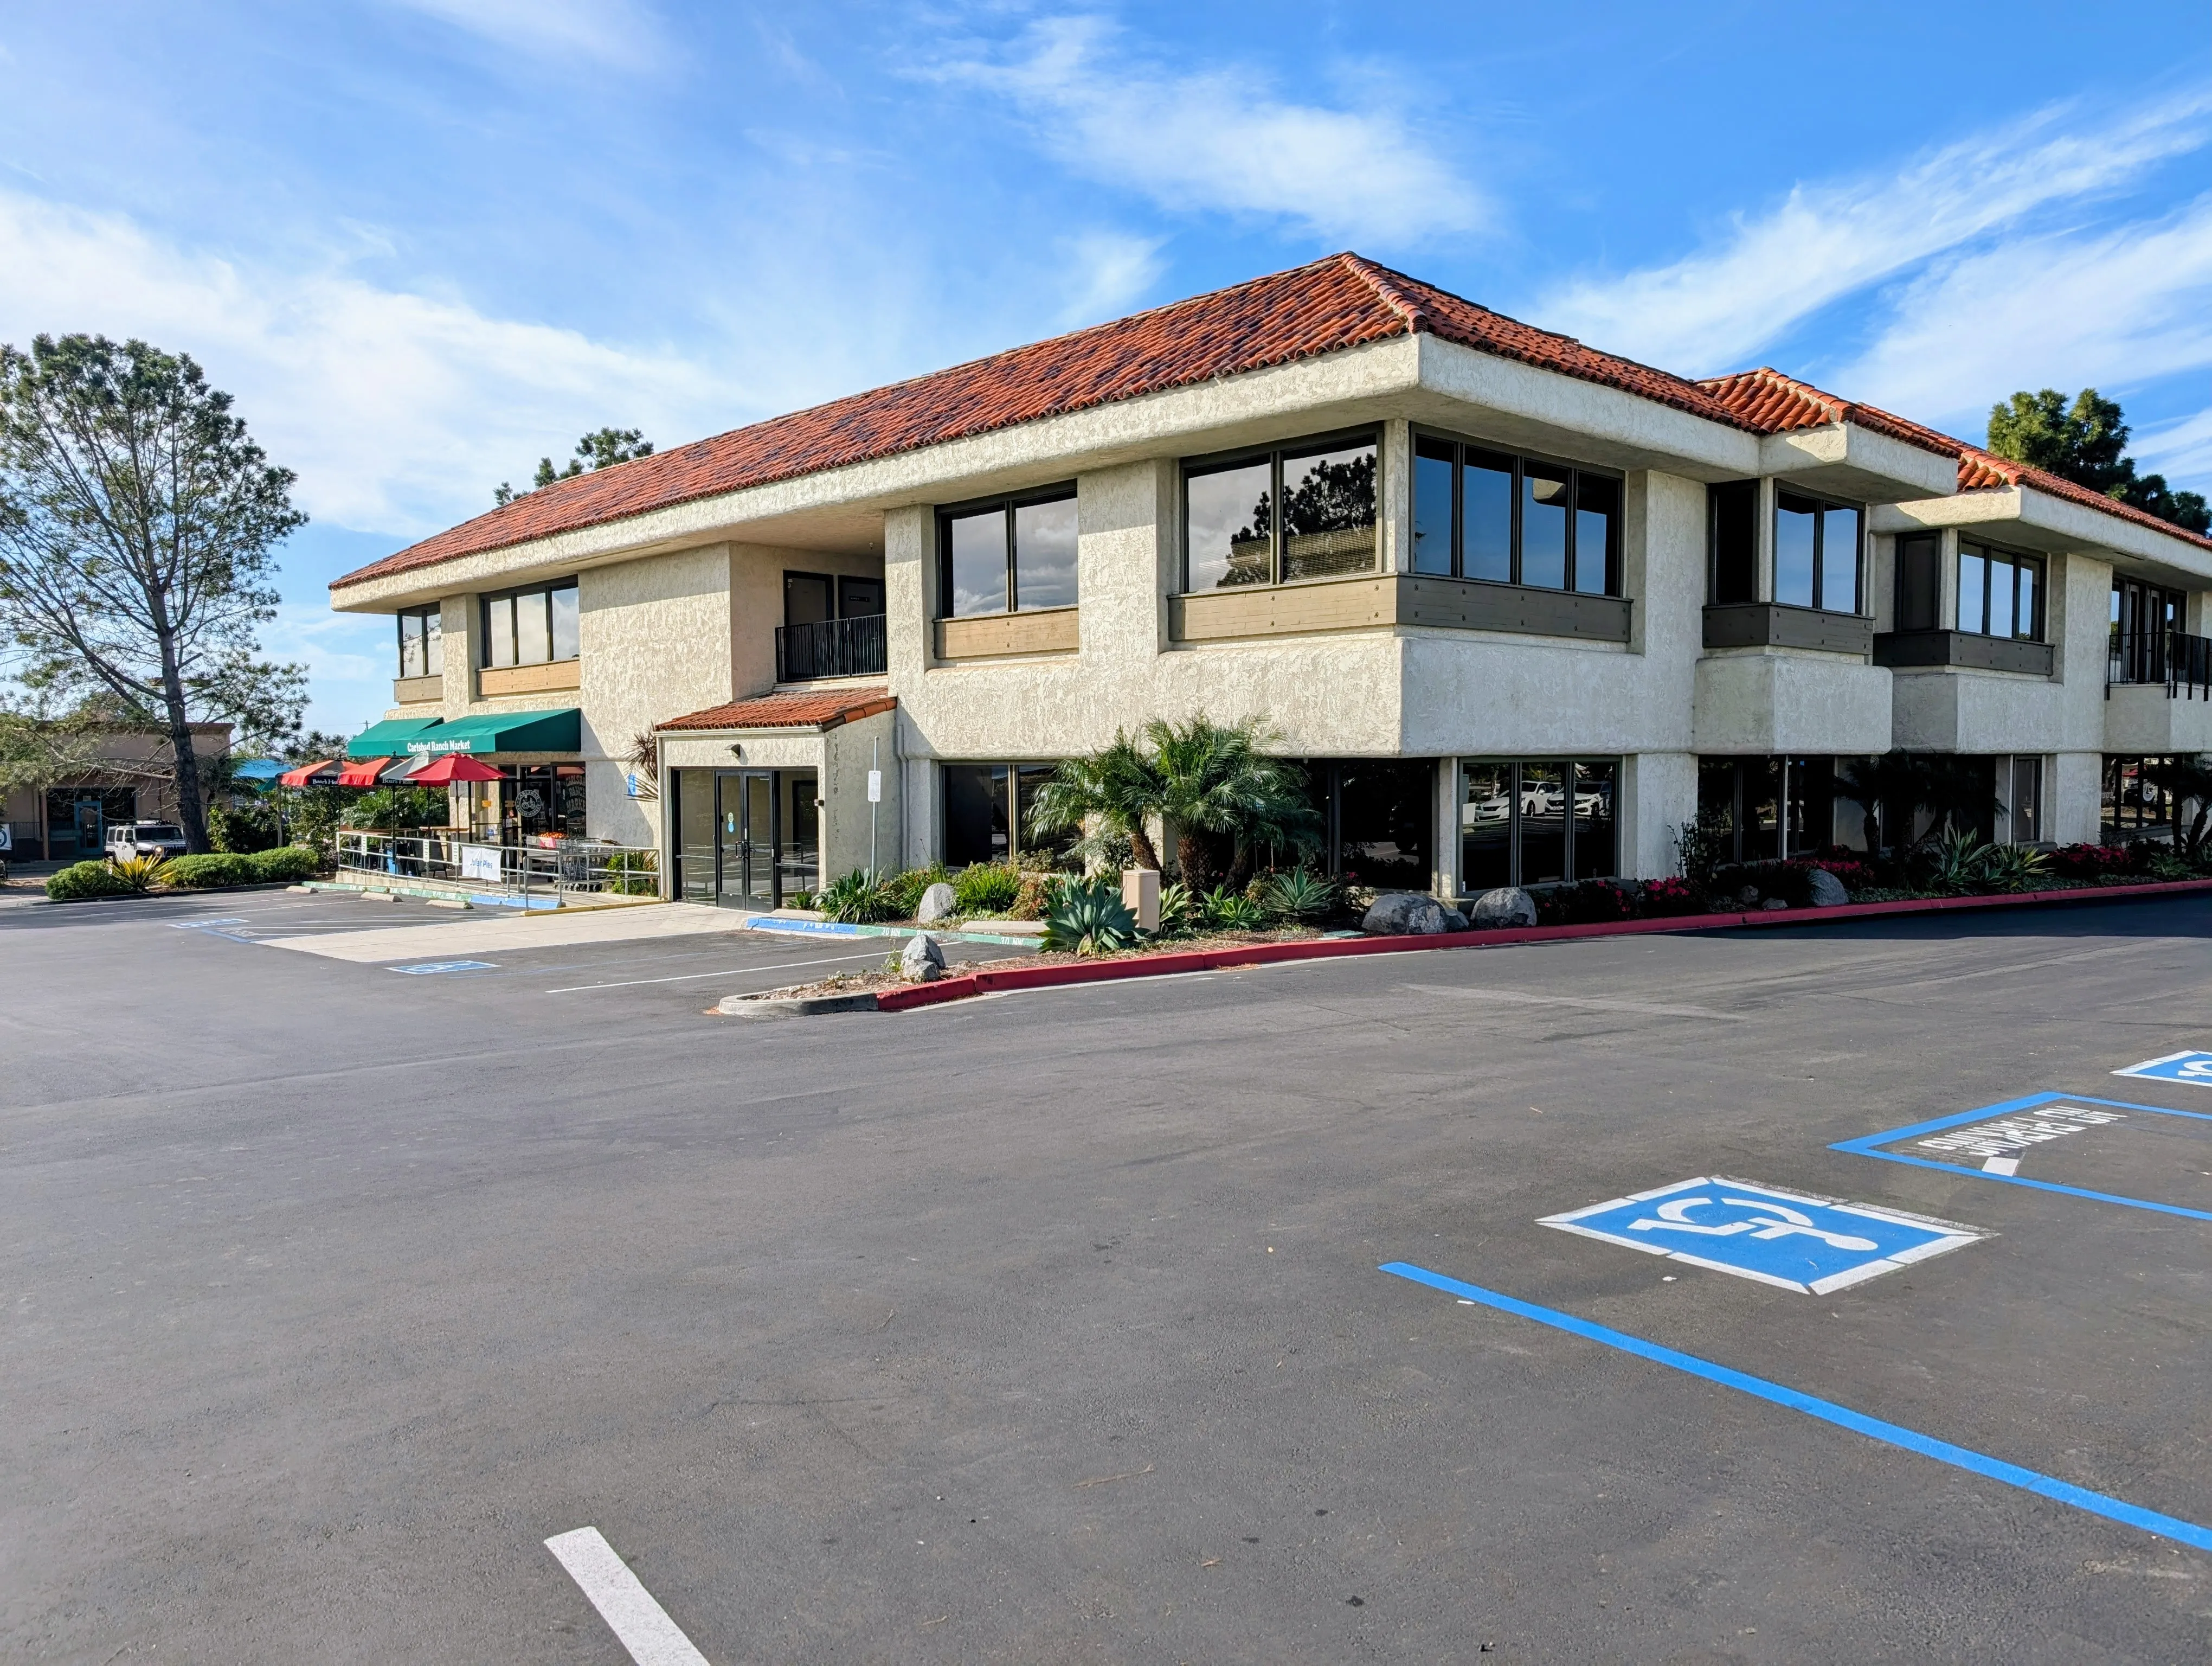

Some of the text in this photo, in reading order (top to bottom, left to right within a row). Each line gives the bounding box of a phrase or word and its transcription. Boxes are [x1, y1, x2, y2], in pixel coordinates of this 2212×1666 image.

[407, 739, 471, 752] Carlsbad Ranch Market
[565, 774, 586, 787] CARLSBA
[566, 798, 586, 812] MARKE
[483, 860, 493, 869] Pies
[881, 927, 890, 935] 30
[890, 927, 901, 937] MIN
[1918, 1105, 2128, 1156] NO PARKING
